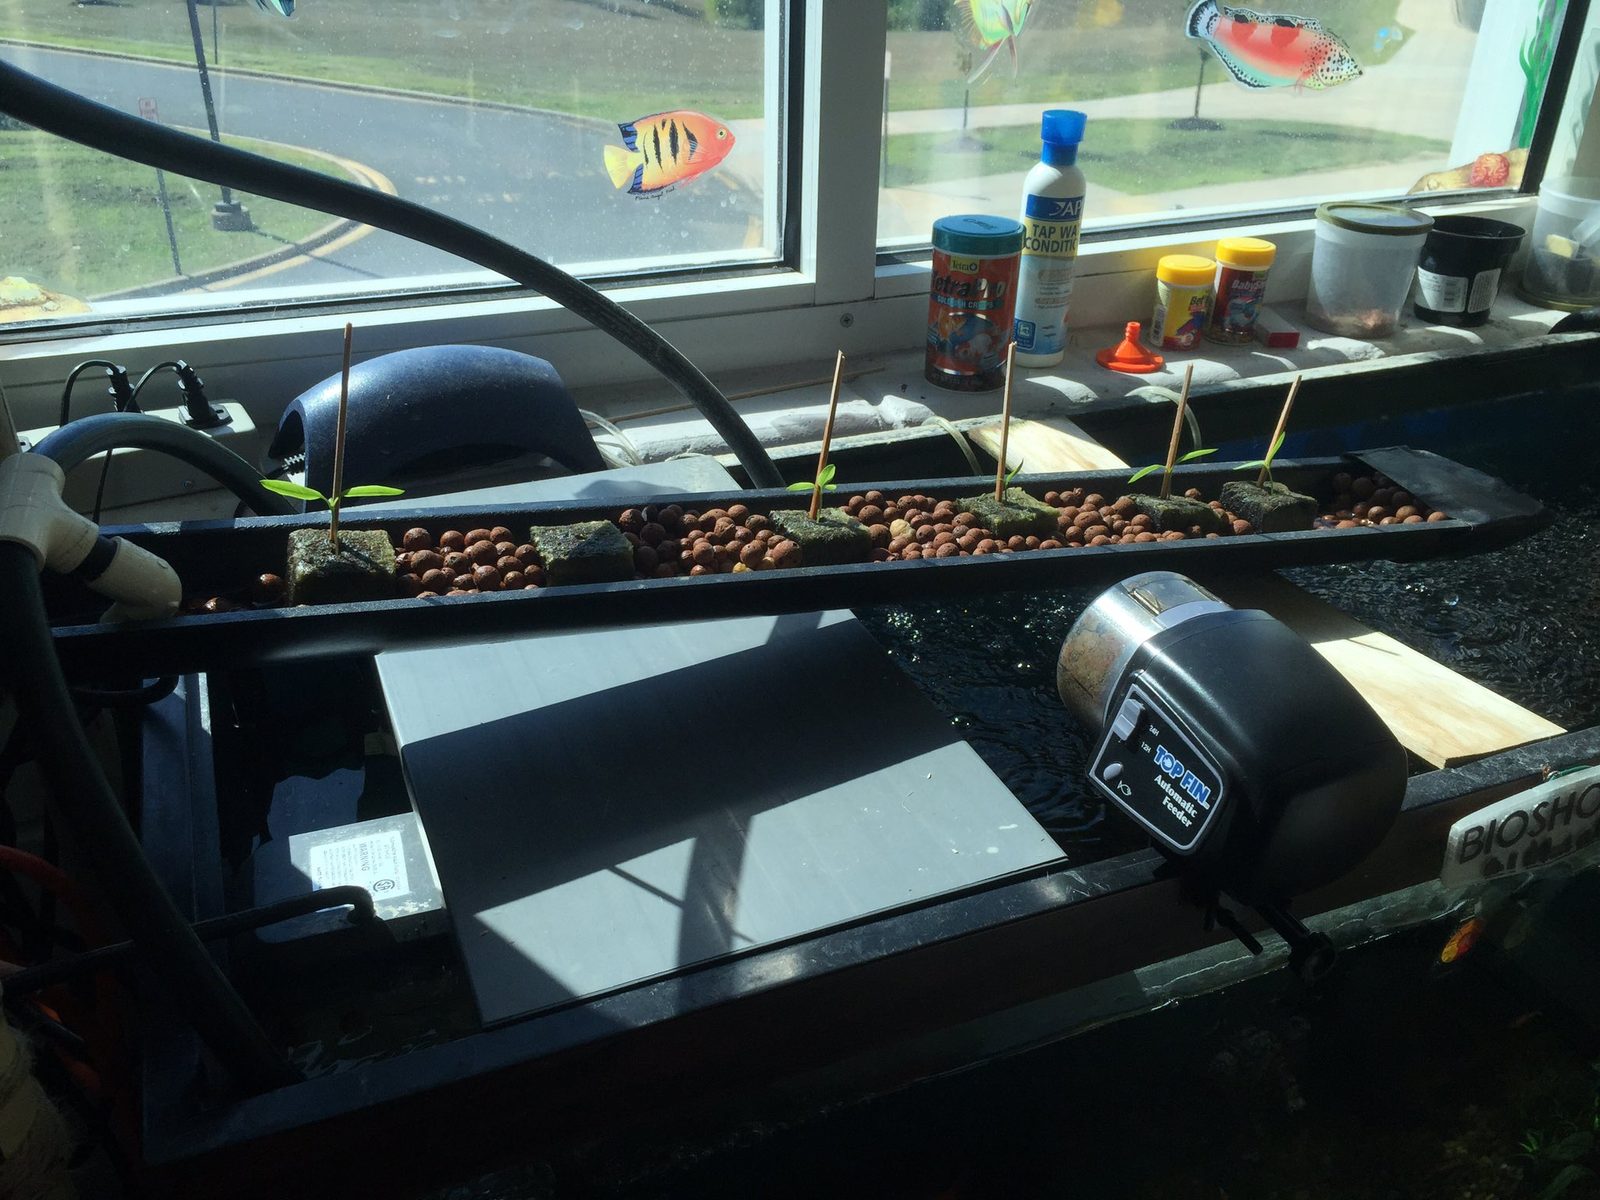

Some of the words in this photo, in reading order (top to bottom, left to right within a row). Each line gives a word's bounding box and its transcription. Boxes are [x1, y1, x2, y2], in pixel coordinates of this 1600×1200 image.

[1033, 224, 1056, 239] TAP
[952, 260, 970, 271] Tetra
[1149, 724, 1160, 737] 24H
[1141, 741, 1152, 753] 12H
[1153, 744, 1185, 779] TOP
[1179, 769, 1212, 806] FIN
[1153, 774, 1198, 818] Automatic
[1161, 795, 1193, 828] Feeder
[359, 842, 370, 872] WARNING
